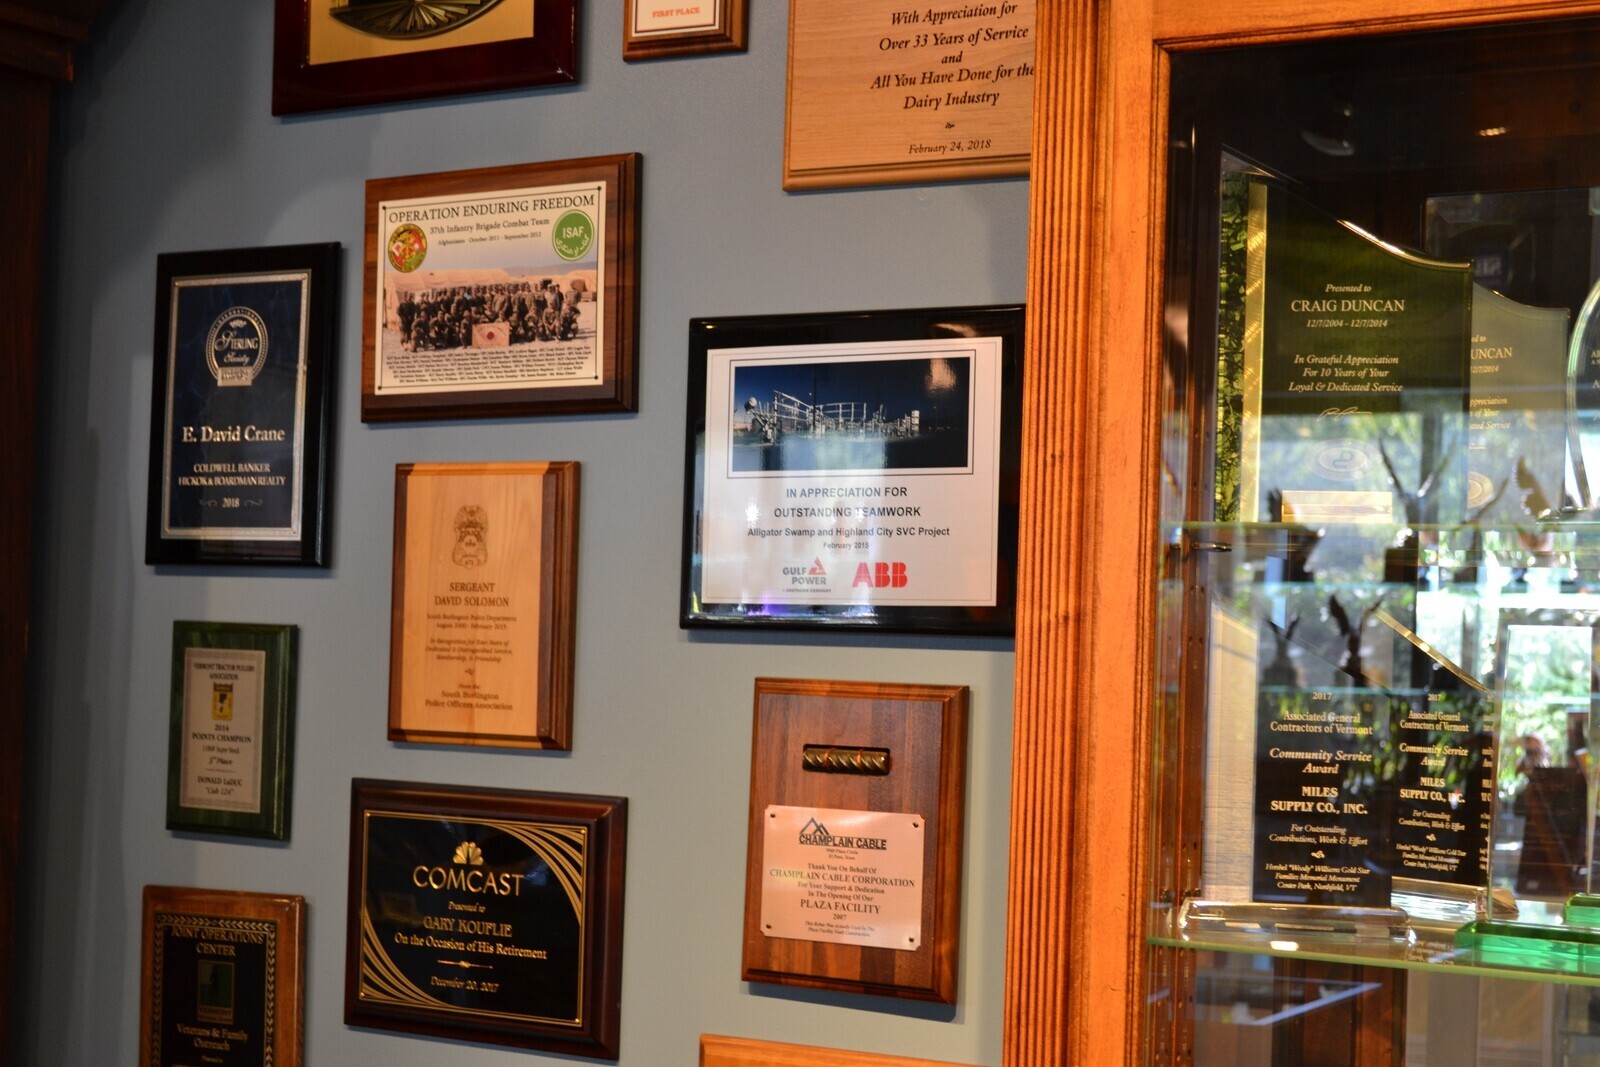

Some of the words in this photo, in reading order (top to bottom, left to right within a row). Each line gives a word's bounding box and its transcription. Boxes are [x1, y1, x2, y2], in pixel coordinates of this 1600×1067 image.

[652, 9, 673, 18] FIRST
[675, 7, 700, 16] PLACE
[891, 11, 919, 25] With
[922, 5, 997, 25] Appreciation
[1000, 3, 1018, 19] for
[880, 37, 910, 51] Over
[913, 35, 929, 49] 33
[932, 32, 964, 47] Years
[967, 30, 981, 45] of
[984, 26, 1029, 40] Service
[941, 51, 963, 64] and
[870, 75, 891, 89] All
[894, 73, 916, 88] You
[919, 70, 954, 86] Have
[958, 67, 992, 82] Done
[994, 65, 1014, 80] for
[904, 95, 941, 111] Dairy
[945, 91, 1000, 109] Industry
[909, 144, 946, 155] February
[950, 142, 964, 152] 24,
[967, 139, 991, 151] 2018
[389, 208, 459, 223] OPERATION
[463, 201, 529, 216] ENDURING
[532, 195, 594, 210] FREEDOM
[430, 225, 444, 234] 37th
[447, 223, 473, 234] Infantry
[476, 221, 500, 232] Brigade
[502, 219, 529, 229] Combat
[532, 217, 549, 227] Team
[563, 227, 583, 239] ISAF
[1326, 284, 1362, 293] Presented
[1291, 300, 1337, 312] CRAIG
[1341, 300, 1404, 312] DUNCAN
[1307, 319, 1342, 328] 12/7/2004
[1350, 319, 1387, 328] 12/7/2014
[1471, 348, 1512, 359] UNCAN
[1295, 355, 1304, 364] In
[1307, 354, 1343, 365] Grateful
[1344, 355, 1398, 366] Appreciation
[1303, 368, 1318, 377] For
[1321, 368, 1331, 377] 10
[1334, 368, 1355, 377] Years
[1358, 368, 1367, 379] of
[1369, 368, 1389, 377] Your
[1289, 382, 1313, 393] Loyal
[1316, 382, 1325, 391] &
[1327, 382, 1369, 392] Dedicated
[1372, 382, 1402, 392] Service
[182, 427, 196, 442] E.
[201, 426, 240, 442] David
[244, 426, 285, 441] Crane
[194, 463, 236, 473] COLDWELL
[238, 463, 270, 472] BANKER
[258, 477, 285, 485] REALTY
[787, 488, 797, 497] IN
[800, 488, 881, 498] APPRECIATION
[885, 487, 907, 497] FOR
[222, 498, 239, 507] 2018
[774, 507, 851, 518] OUTSTANDING
[856, 507, 920, 517] TEAMWORK
[748, 528, 782, 537] Alligator
[785, 528, 815, 537] Swamp
[818, 528, 833, 536] and
[836, 527, 874, 537] Highland
[876, 527, 894, 537] City
[896, 528, 915, 536] SVC
[918, 527, 950, 537] Project
[823, 541, 852, 550] February
[783, 567, 806, 575] GULF
[853, 562, 907, 588] ABB
[792, 577, 826, 585] POWER
[450, 582, 495, 592] SERGEANT
[435, 596, 461, 605] DAVID
[464, 596, 509, 607] SOLOMON
[1313, 692, 1331, 700] 2017
[1284, 711, 1326, 721] Associated
[1328, 713, 1360, 723] General
[1409, 710, 1437, 720] Associated
[1438, 712, 1460, 721] General
[1270, 721, 1321, 732] Contractors
[1324, 723, 1335, 733] of
[1336, 724, 1372, 735] Vermont
[1400, 720, 1434, 729] Contractors
[1442, 722, 1469, 732] Vermont
[1270, 748, 1334, 762] Community
[1337, 751, 1372, 762] Service
[1400, 743, 1441, 756] Community
[1443, 746, 1468, 756] Service
[1421, 756, 1445, 766] Award
[1302, 763, 1339, 774] Award
[1421, 777, 1445, 787] MILES
[1302, 786, 1338, 797] MILES
[1400, 789, 1429, 799] SUPPLY
[1271, 801, 1314, 812] SUPPLY
[1316, 802, 1340, 814] CO.,
[1343, 803, 1367, 815] INC.
[1304, 825, 1346, 835] Outstanding
[799, 834, 853, 847] CHAMPLAIN
[856, 838, 887, 850] CABLE
[1320, 836, 1337, 844] Work
[1348, 837, 1368, 847] Effort
[808, 863, 825, 871] Thank
[826, 864, 838, 872] You
[413, 865, 524, 896] COMCAST
[770, 869, 820, 880] CHAMPLAIN
[822, 873, 849, 882] CABLE
[852, 875, 914, 887] CORPORATION
[823, 883, 847, 892] Support
[854, 886, 885, 894] Dedication
[828, 892, 851, 901] Opening
[800, 899, 832, 910] PLAZA
[835, 901, 881, 914] FACILITY
[424, 916, 454, 930] GARY
[172, 925, 200, 938] JOINT
[201, 928, 264, 944] OPERATIONS
[197, 943, 235, 956] CENTER
[395, 933, 408, 944] On
[410, 935, 424, 946] the
[426, 936, 464, 950] Occasion
[467, 940, 476, 951] of
[478, 942, 494, 954] His
[496, 943, 547, 959] Retirement
